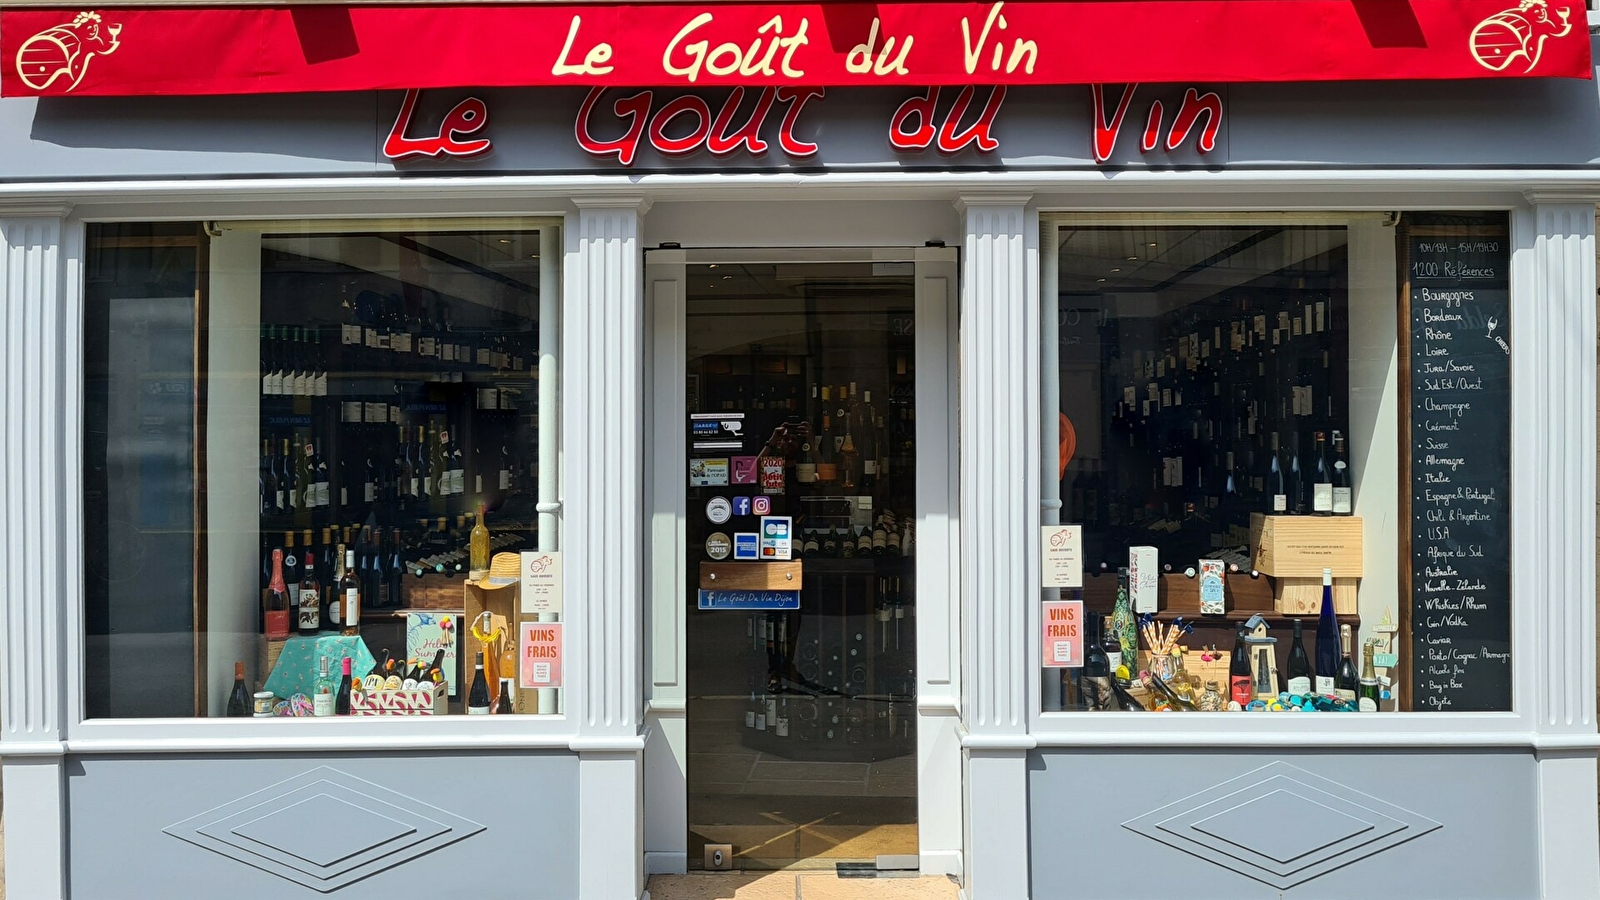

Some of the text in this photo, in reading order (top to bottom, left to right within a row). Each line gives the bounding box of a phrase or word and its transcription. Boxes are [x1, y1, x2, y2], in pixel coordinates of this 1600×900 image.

[552, 1, 1040, 82] Le Goût du Vin
[382, 88, 492, 157] Le
[889, 87, 1007, 152] du
[1091, 84, 1223, 163] Vin
[1412, 261, 1495, 281] 1200 Références
[1422, 287, 1474, 307] Bourgognes
[1424, 308, 1463, 323] Bordeaux
[1425, 327, 1453, 341] Rhône
[1425, 343, 1449, 357] Loire
[1424, 379, 1441, 391] Sud
[1424, 397, 1471, 418] Champagne
[1425, 418, 1460, 432] Crémant
[1425, 437, 1449, 450] Suisse
[763, 458, 783, 467] 2020
[1425, 454, 1465, 472] Allemagne
[1425, 471, 1451, 484] Italie
[1456, 508, 1492, 526] Argentine
[1427, 544, 1484, 565] Afrique du Sud
[1425, 565, 1458, 578] Australie
[717, 592, 726, 602] Le
[760, 592, 773, 602] Vin
[774, 592, 793, 607] Dijon
[1050, 608, 1074, 620] VINS
[530, 629, 555, 642] VINS
[1048, 624, 1077, 637] FRAIS
[1426, 632, 1452, 645] Caviar
[527, 645, 557, 658] FRAIS
[1428, 679, 1443, 694] Bag
[1450, 678, 1463, 689] Box
